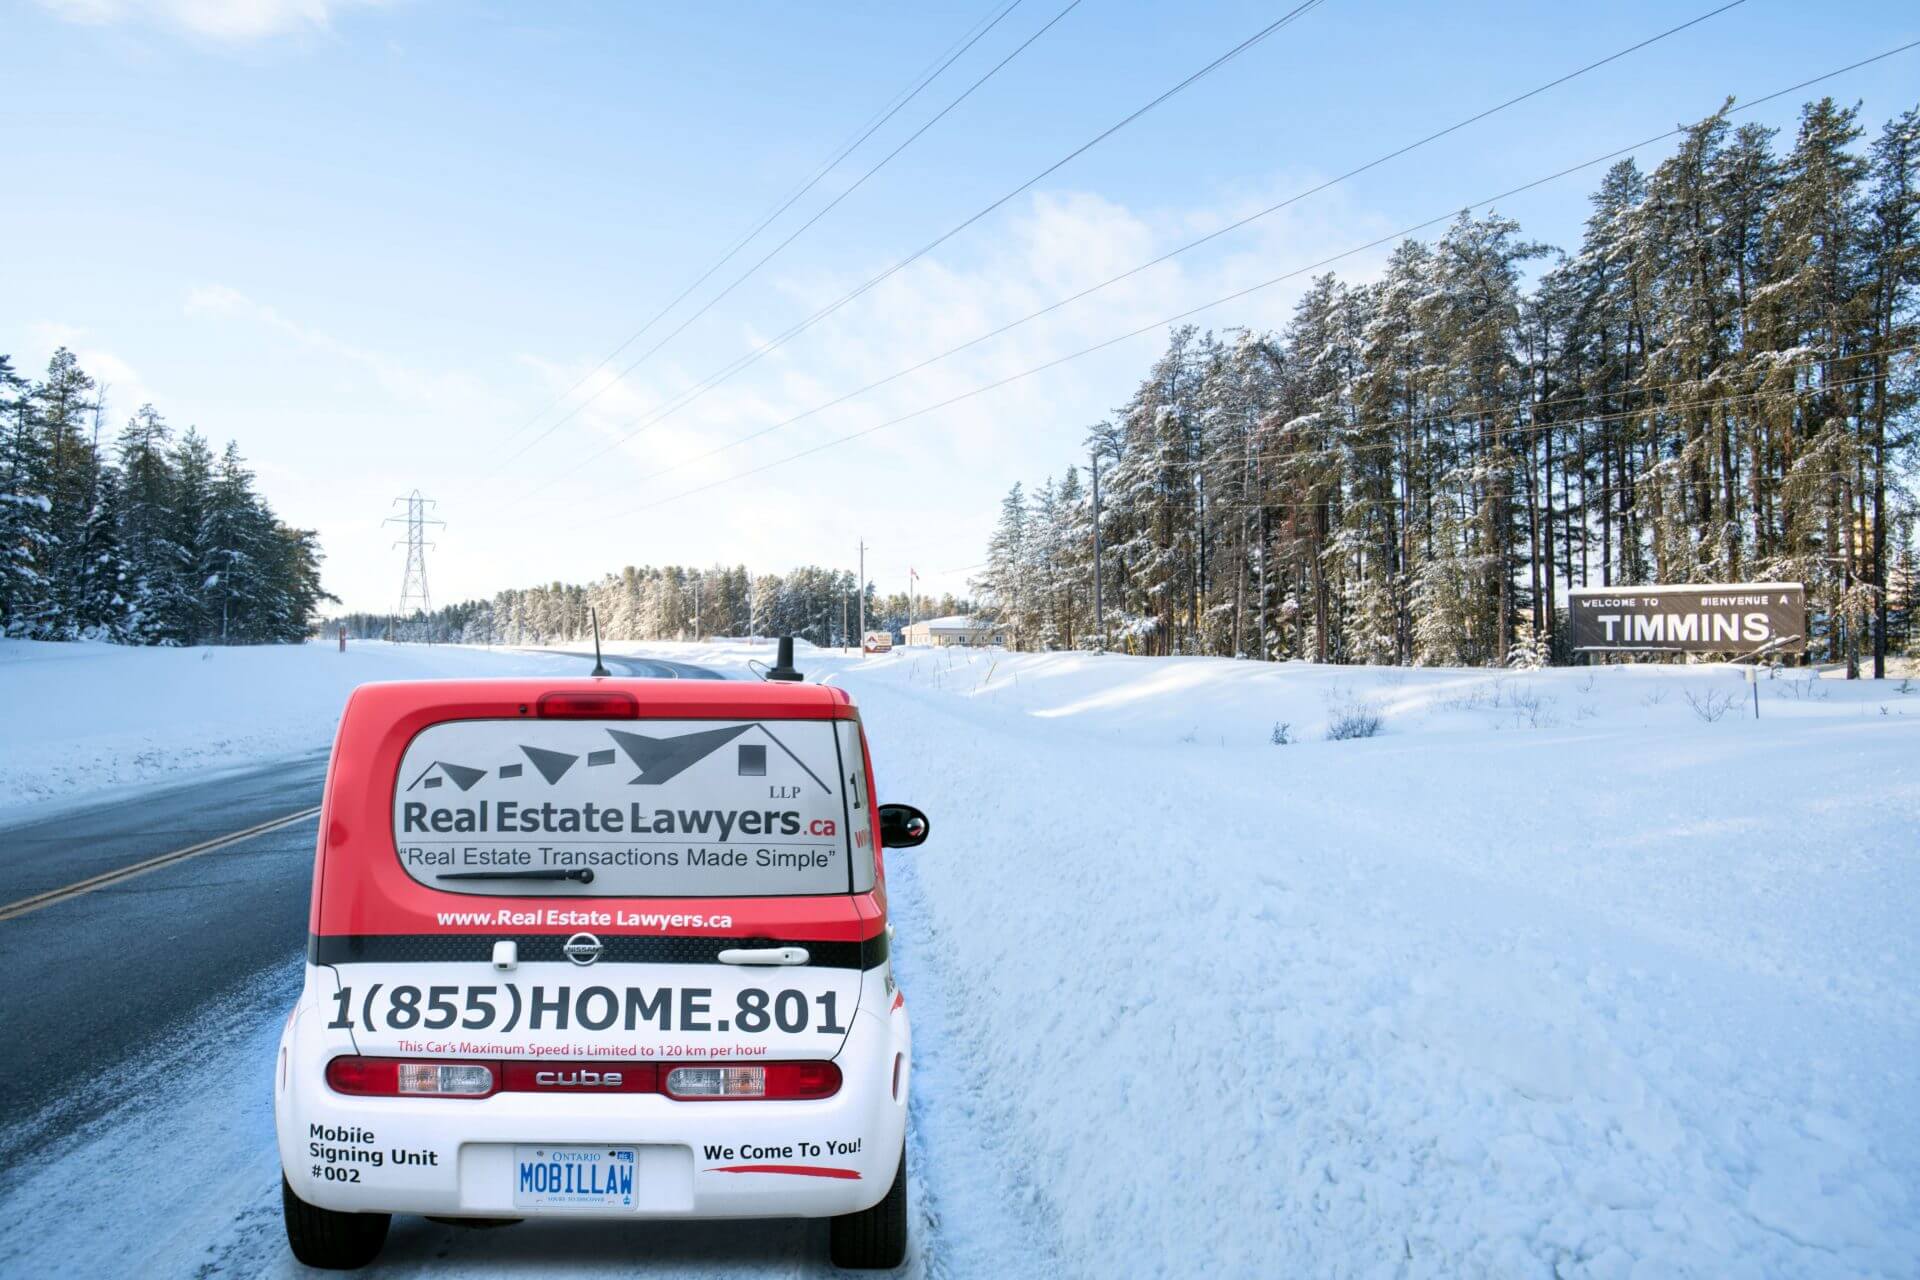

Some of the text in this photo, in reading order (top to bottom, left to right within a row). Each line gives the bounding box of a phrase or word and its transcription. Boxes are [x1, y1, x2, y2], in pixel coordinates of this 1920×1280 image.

[1582, 598, 1659, 608] WELCOME TO
[1701, 595, 1769, 606] BIENVENUE
[1598, 613, 1770, 641] TIMMINS
[769, 785, 801, 799] LLP
[463, 848, 532, 866] Estate
[538, 848, 679, 867] Transactions
[687, 848, 748, 867] Made
[397, 1040, 423, 1053] This
[459, 1042, 525, 1055] Maximum
[528, 1043, 570, 1057] Speed
[573, 1043, 584, 1056] is
[587, 1044, 634, 1057] Limited
[640, 1045, 655, 1057] to
[659, 1045, 683, 1057] 120
[686, 1044, 707, 1057] km
[710, 1046, 732, 1059] per
[735, 1044, 768, 1056] hour
[535, 1069, 623, 1087] cube
[310, 1142, 439, 1167] Signing Unit
[704, 1137, 862, 1160] We Come To You!
[312, 1164, 361, 1184] #002
[520, 1162, 633, 1194] MOBILLAW
